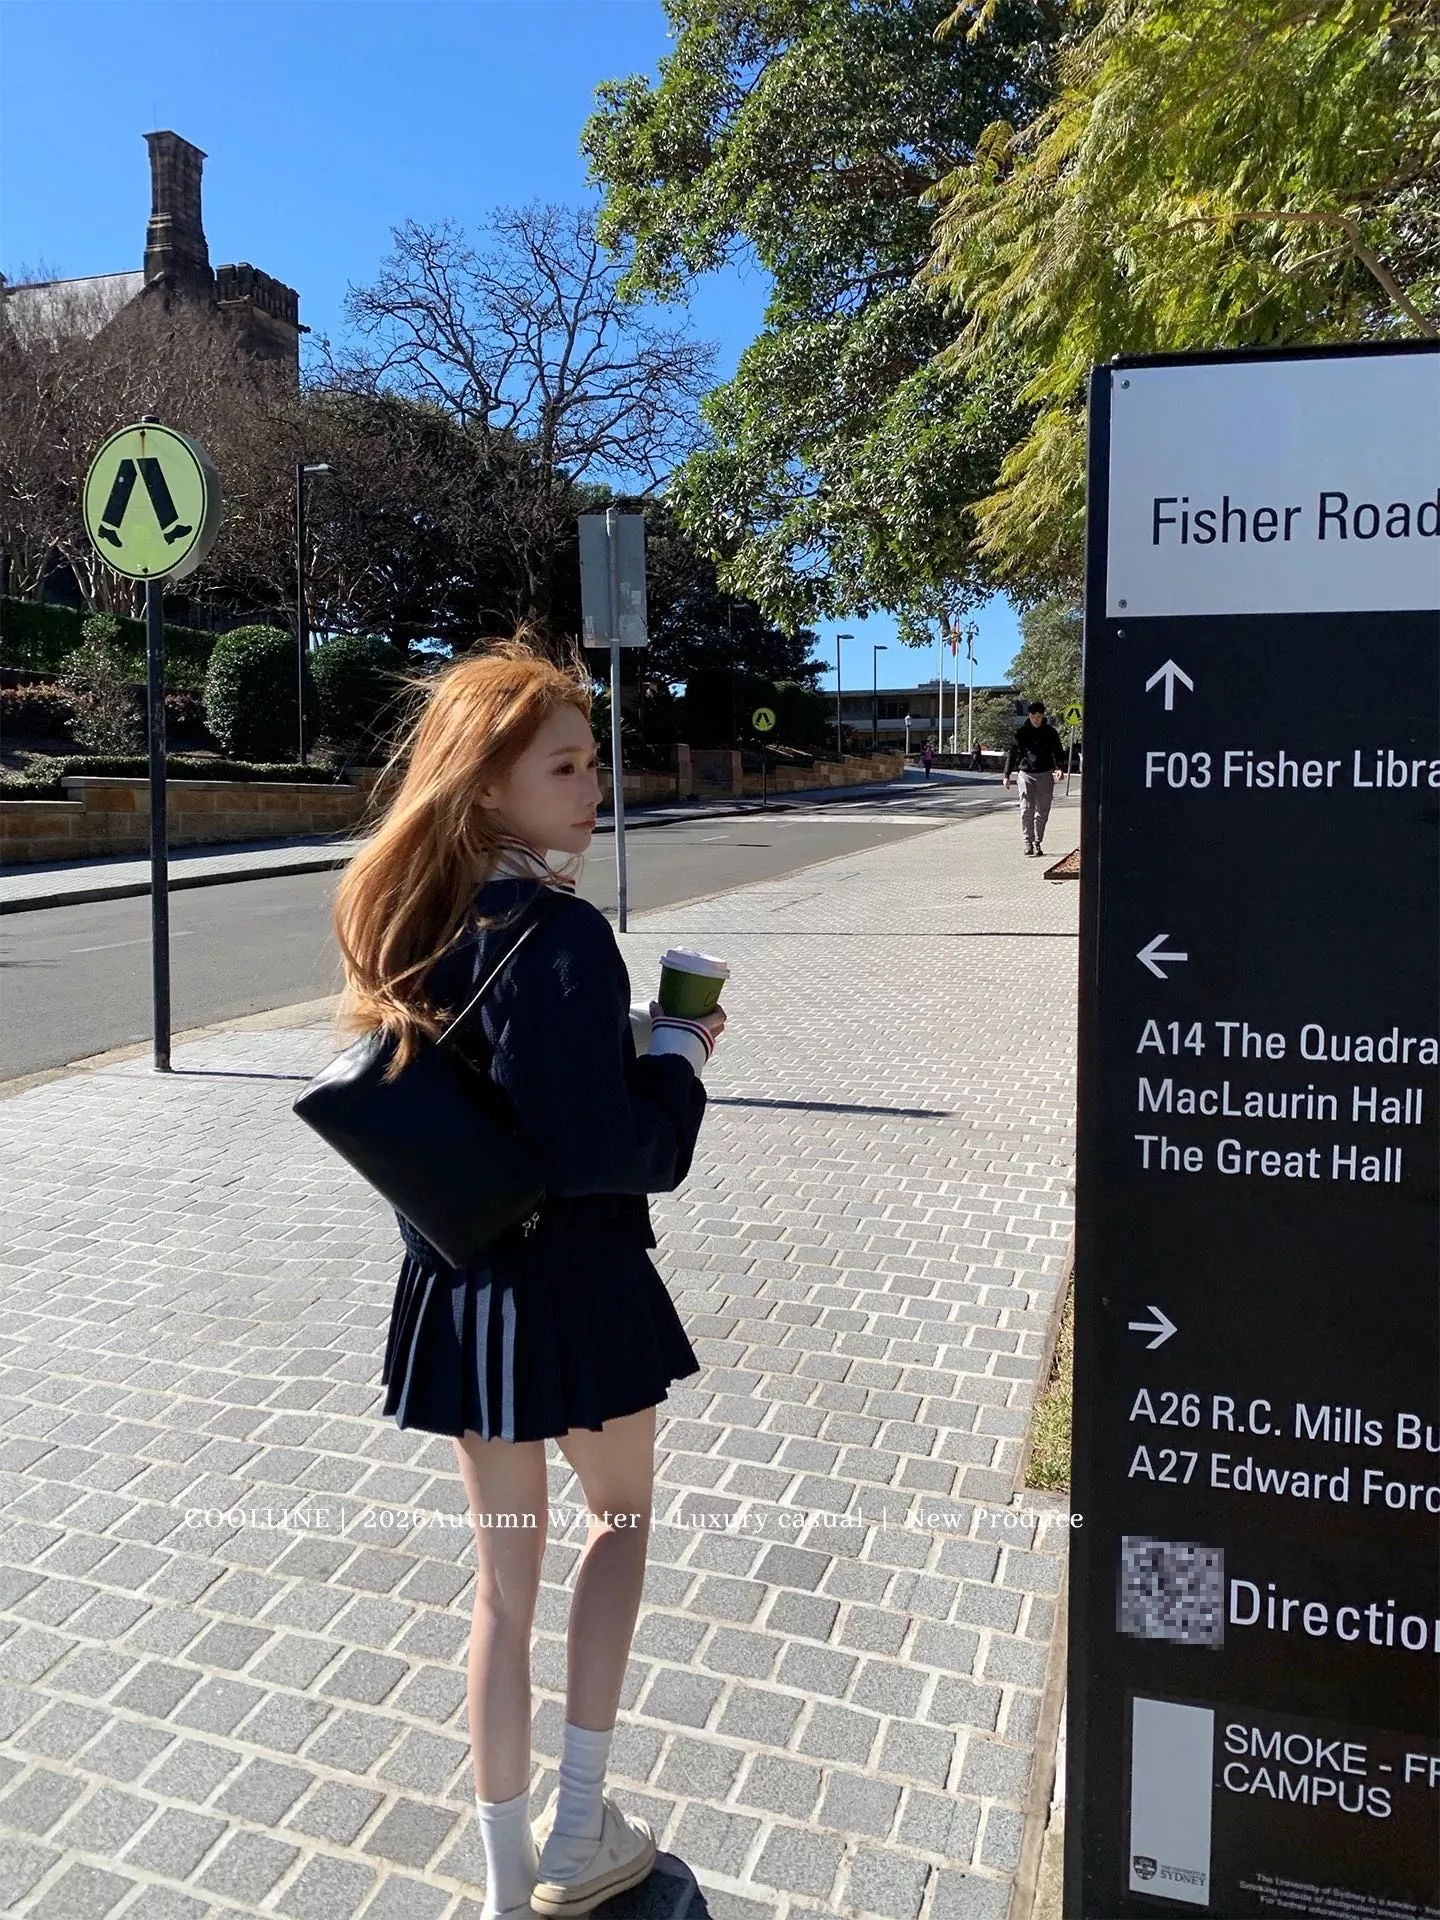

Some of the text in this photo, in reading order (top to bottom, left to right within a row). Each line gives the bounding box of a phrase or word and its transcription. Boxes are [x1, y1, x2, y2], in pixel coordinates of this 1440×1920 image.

[1152, 487, 1440, 546] Fisher Road
[1145, 751, 1212, 789] F03
[1223, 750, 1342, 788] Fisher
[1136, 1019, 1439, 1065] A14 The Quadra
[1138, 1077, 1423, 1125] MacLaurin Hall
[1134, 1134, 1402, 1183] The Great Hall
[1129, 1388, 1440, 1453] A26 R.C. Mills Bu
[1127, 1445, 1199, 1484] A27
[1210, 1452, 1350, 1503] Edward
[1230, 1578, 1440, 1653] Directio
[1224, 1723, 1368, 1776] SMOKE
[1223, 1762, 1392, 1818] CAMPUS
[1160, 1869, 1206, 1886] SYDNEY
